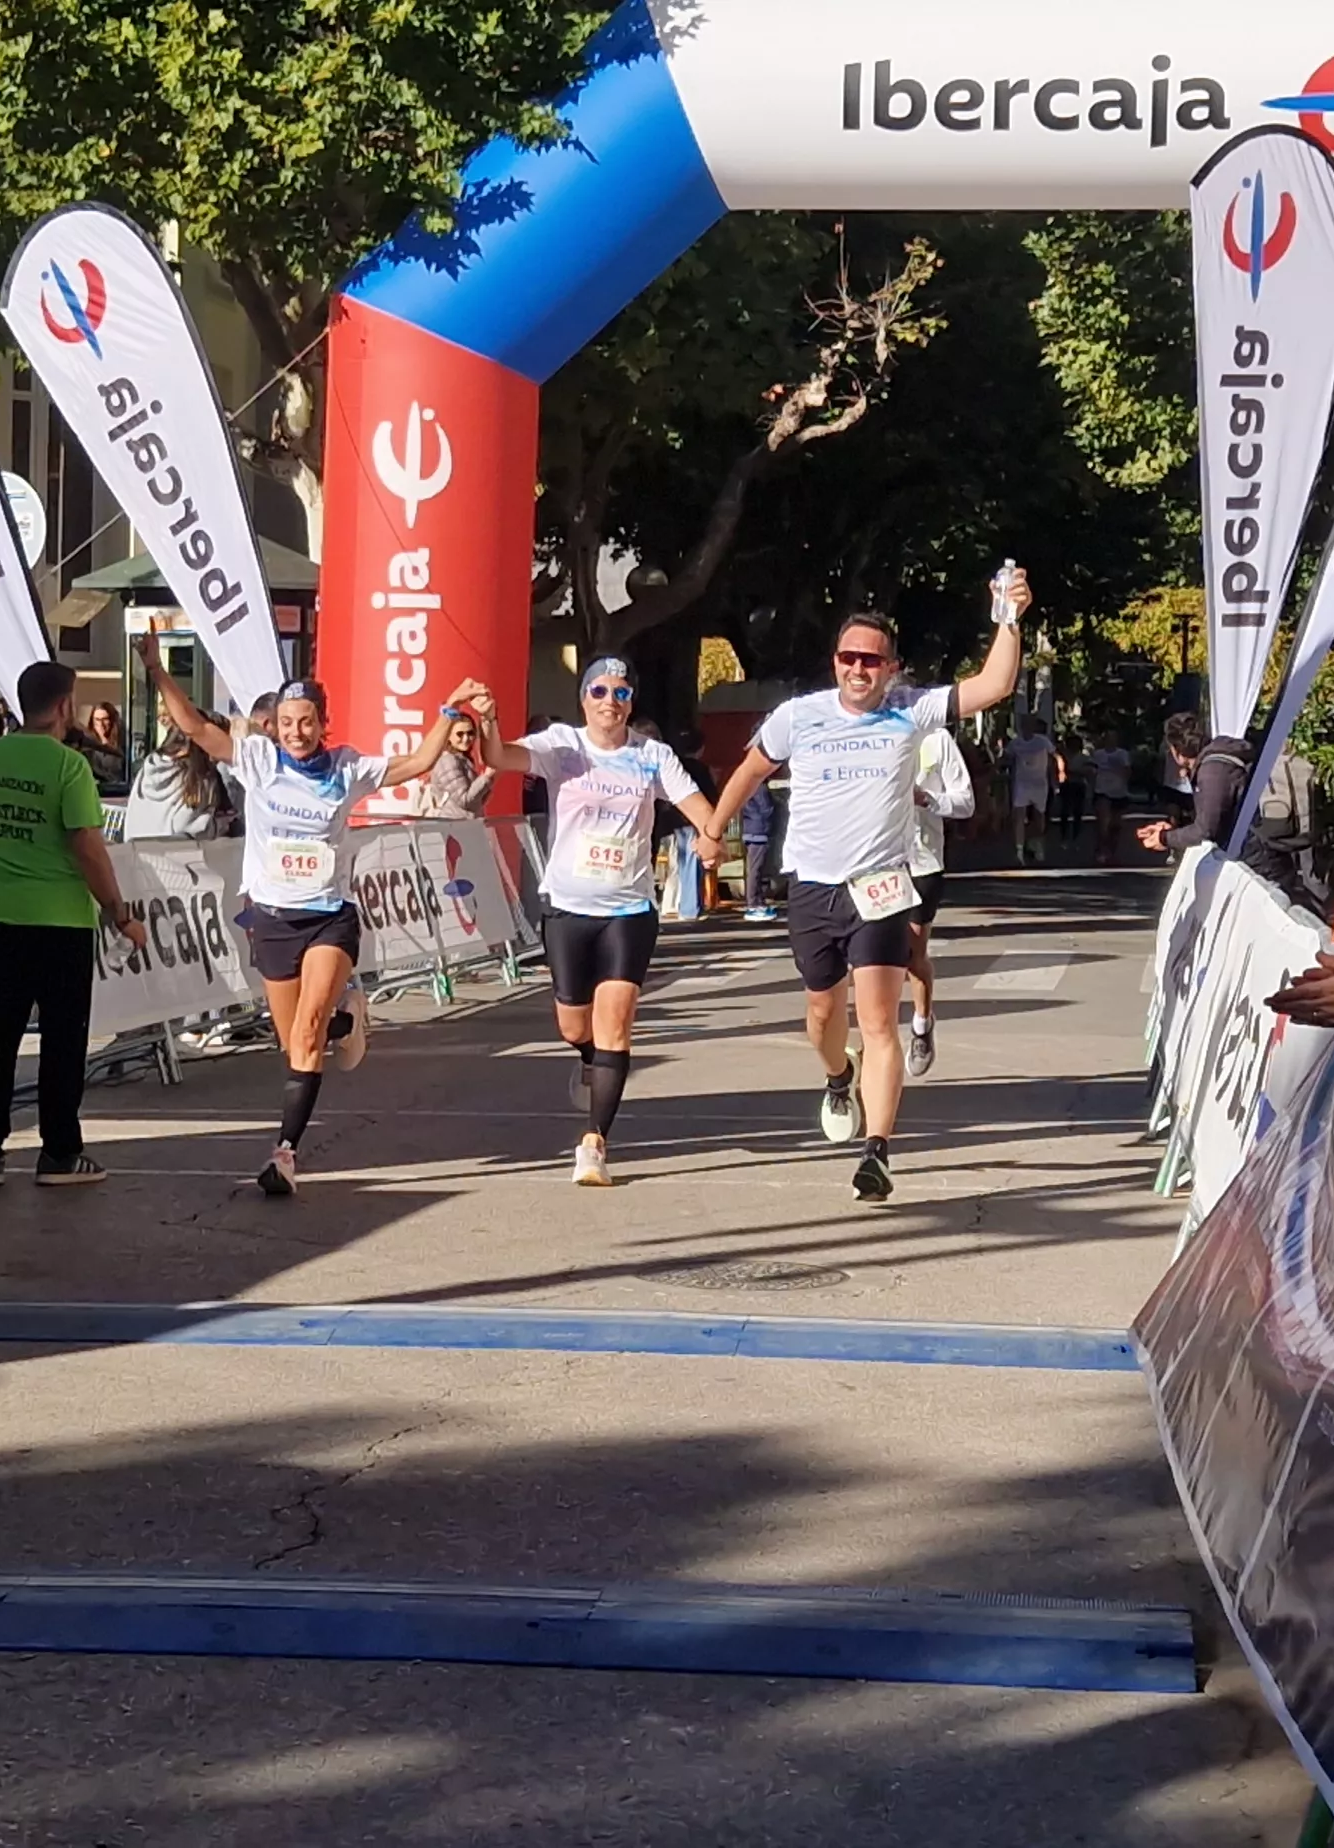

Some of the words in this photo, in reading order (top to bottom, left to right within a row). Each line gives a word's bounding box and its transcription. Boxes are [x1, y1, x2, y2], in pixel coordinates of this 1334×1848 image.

[842, 53, 1232, 149] Ibercaja
[281, 854, 318, 870] 616
[589, 845, 625, 864] 615
[866, 875, 899, 900] 617
